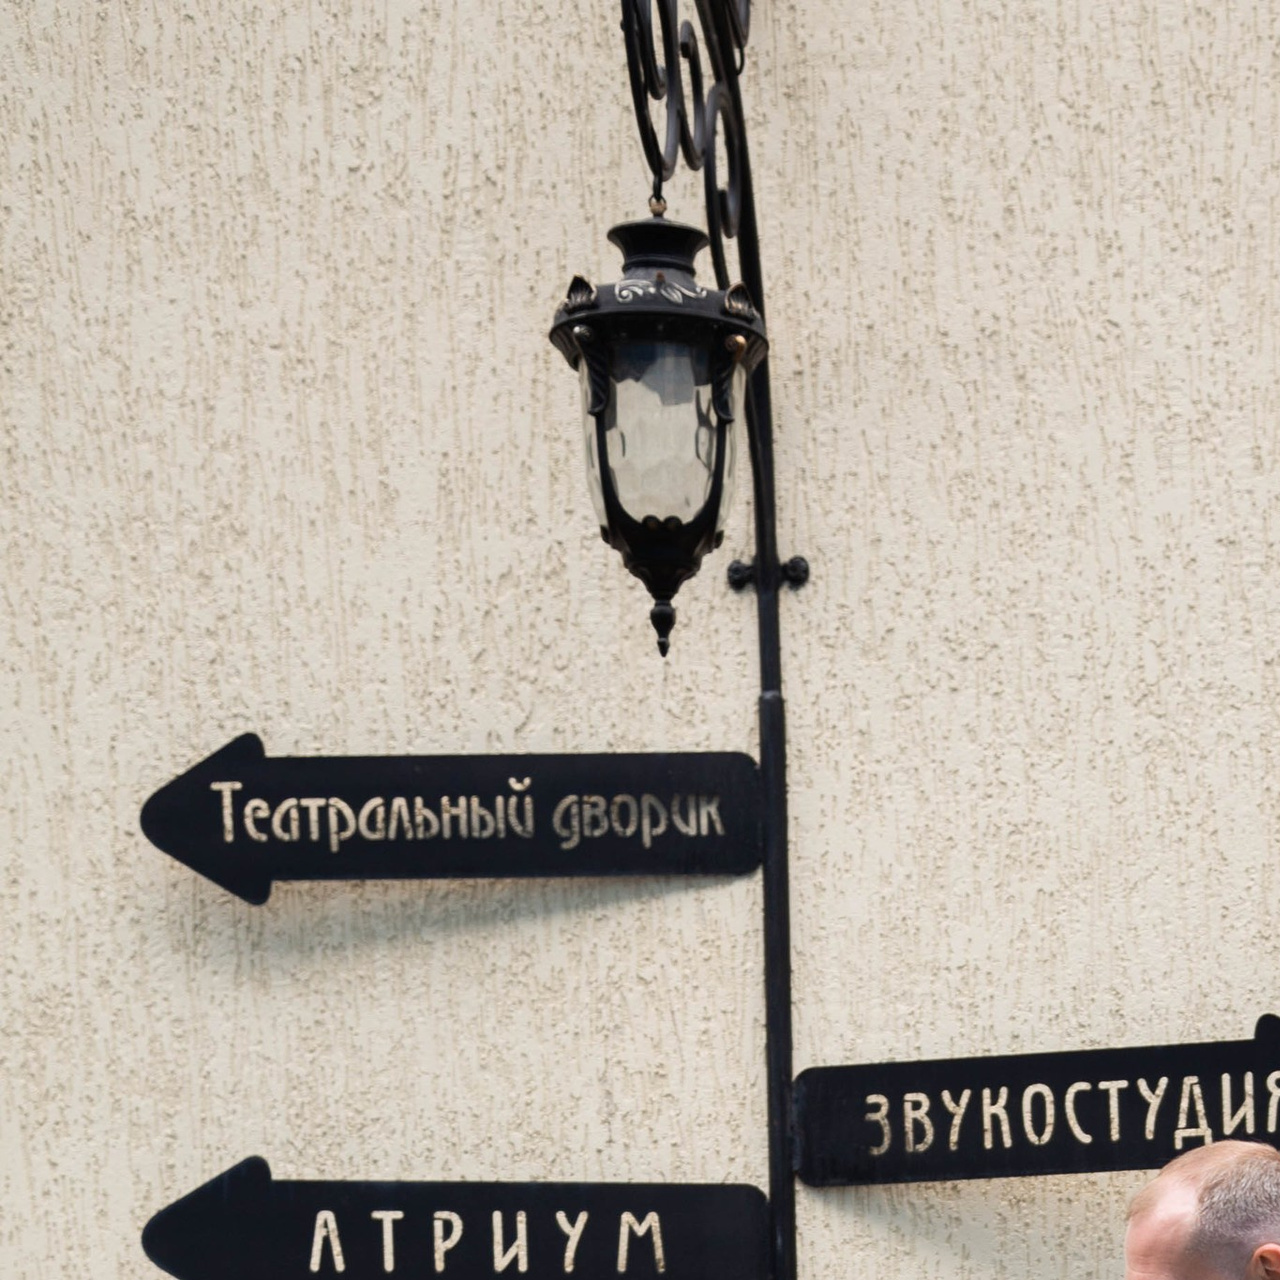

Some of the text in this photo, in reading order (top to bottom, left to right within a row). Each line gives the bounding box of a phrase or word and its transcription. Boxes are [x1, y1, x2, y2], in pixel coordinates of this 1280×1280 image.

[210, 776, 727, 854] Театральный дворик
[309, 1209, 667, 1274] АТРИУМ
